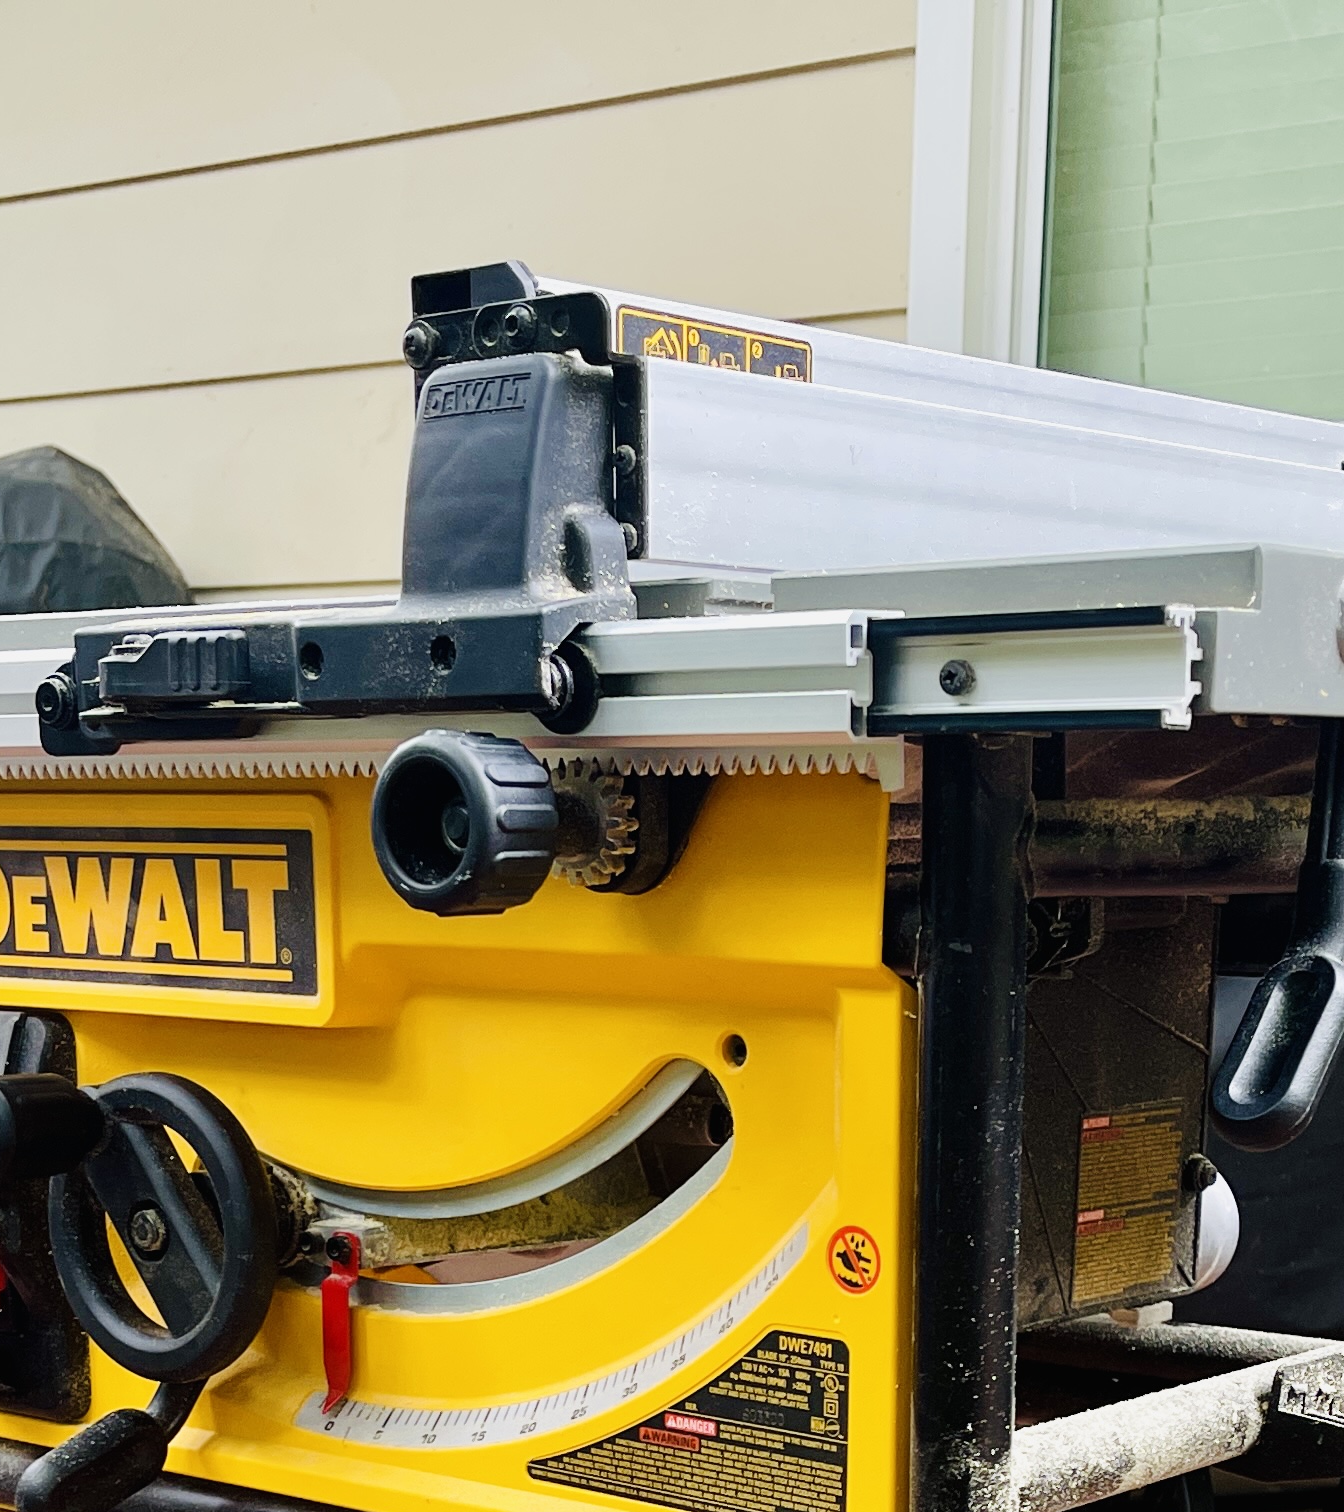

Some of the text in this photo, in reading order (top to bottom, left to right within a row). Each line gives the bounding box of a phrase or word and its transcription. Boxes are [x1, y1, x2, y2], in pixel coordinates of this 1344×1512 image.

[778, 1335, 833, 1358] DWE7491
[324, 1420, 335, 1431] 0
[372, 1430, 384, 1440] 5
[422, 1433, 437, 1445] 10
[471, 1431, 487, 1442] 15
[519, 1421, 537, 1435] 20
[570, 1405, 587, 1420] 25
[621, 1382, 638, 1398] 30
[675, 1416, 716, 1435] DANGER
[651, 1430, 697, 1450] WARNING
